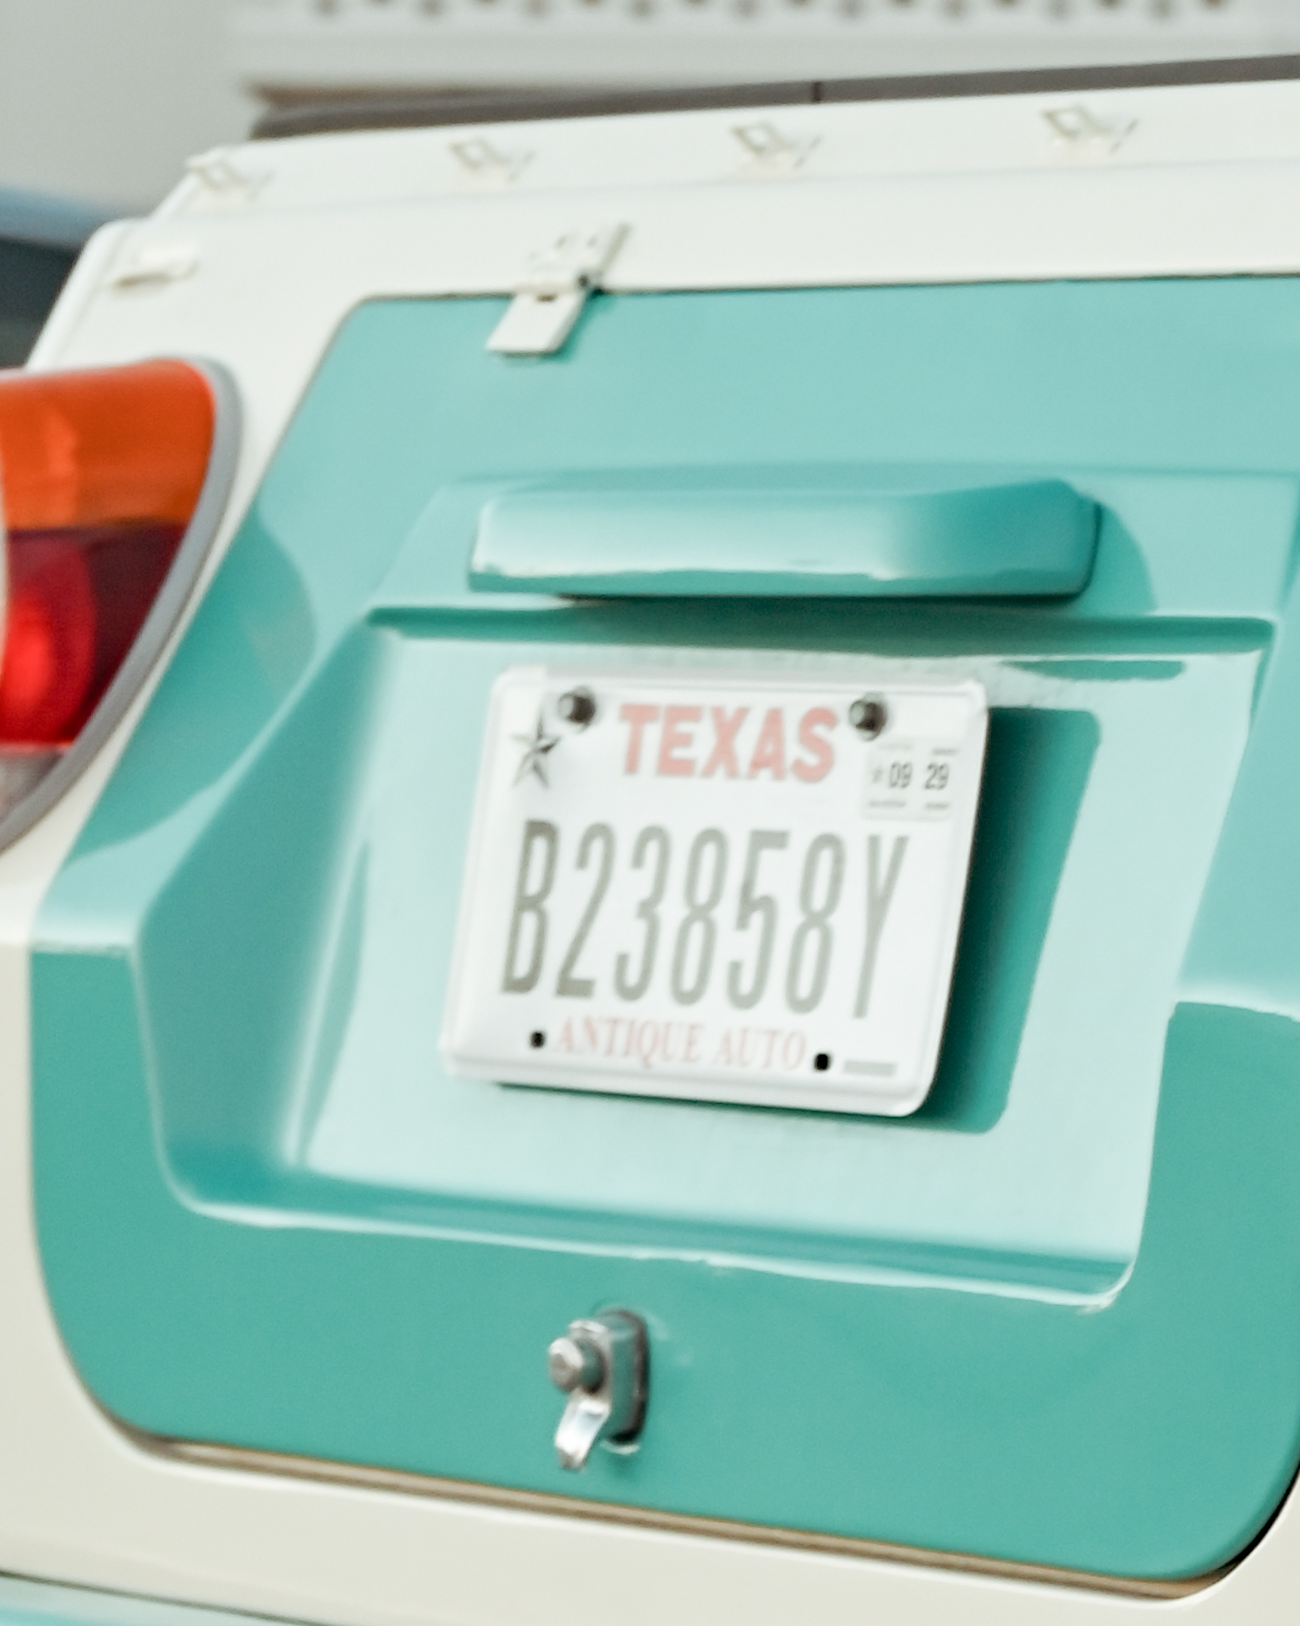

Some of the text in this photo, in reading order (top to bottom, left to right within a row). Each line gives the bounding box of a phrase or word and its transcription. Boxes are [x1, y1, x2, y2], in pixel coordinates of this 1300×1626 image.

[619, 702, 838, 785] TEXAS
[888, 760, 913, 789] 09
[500, 818, 909, 1020] B23858Y
[557, 1018, 808, 1071] ANTIQUE AUTO
